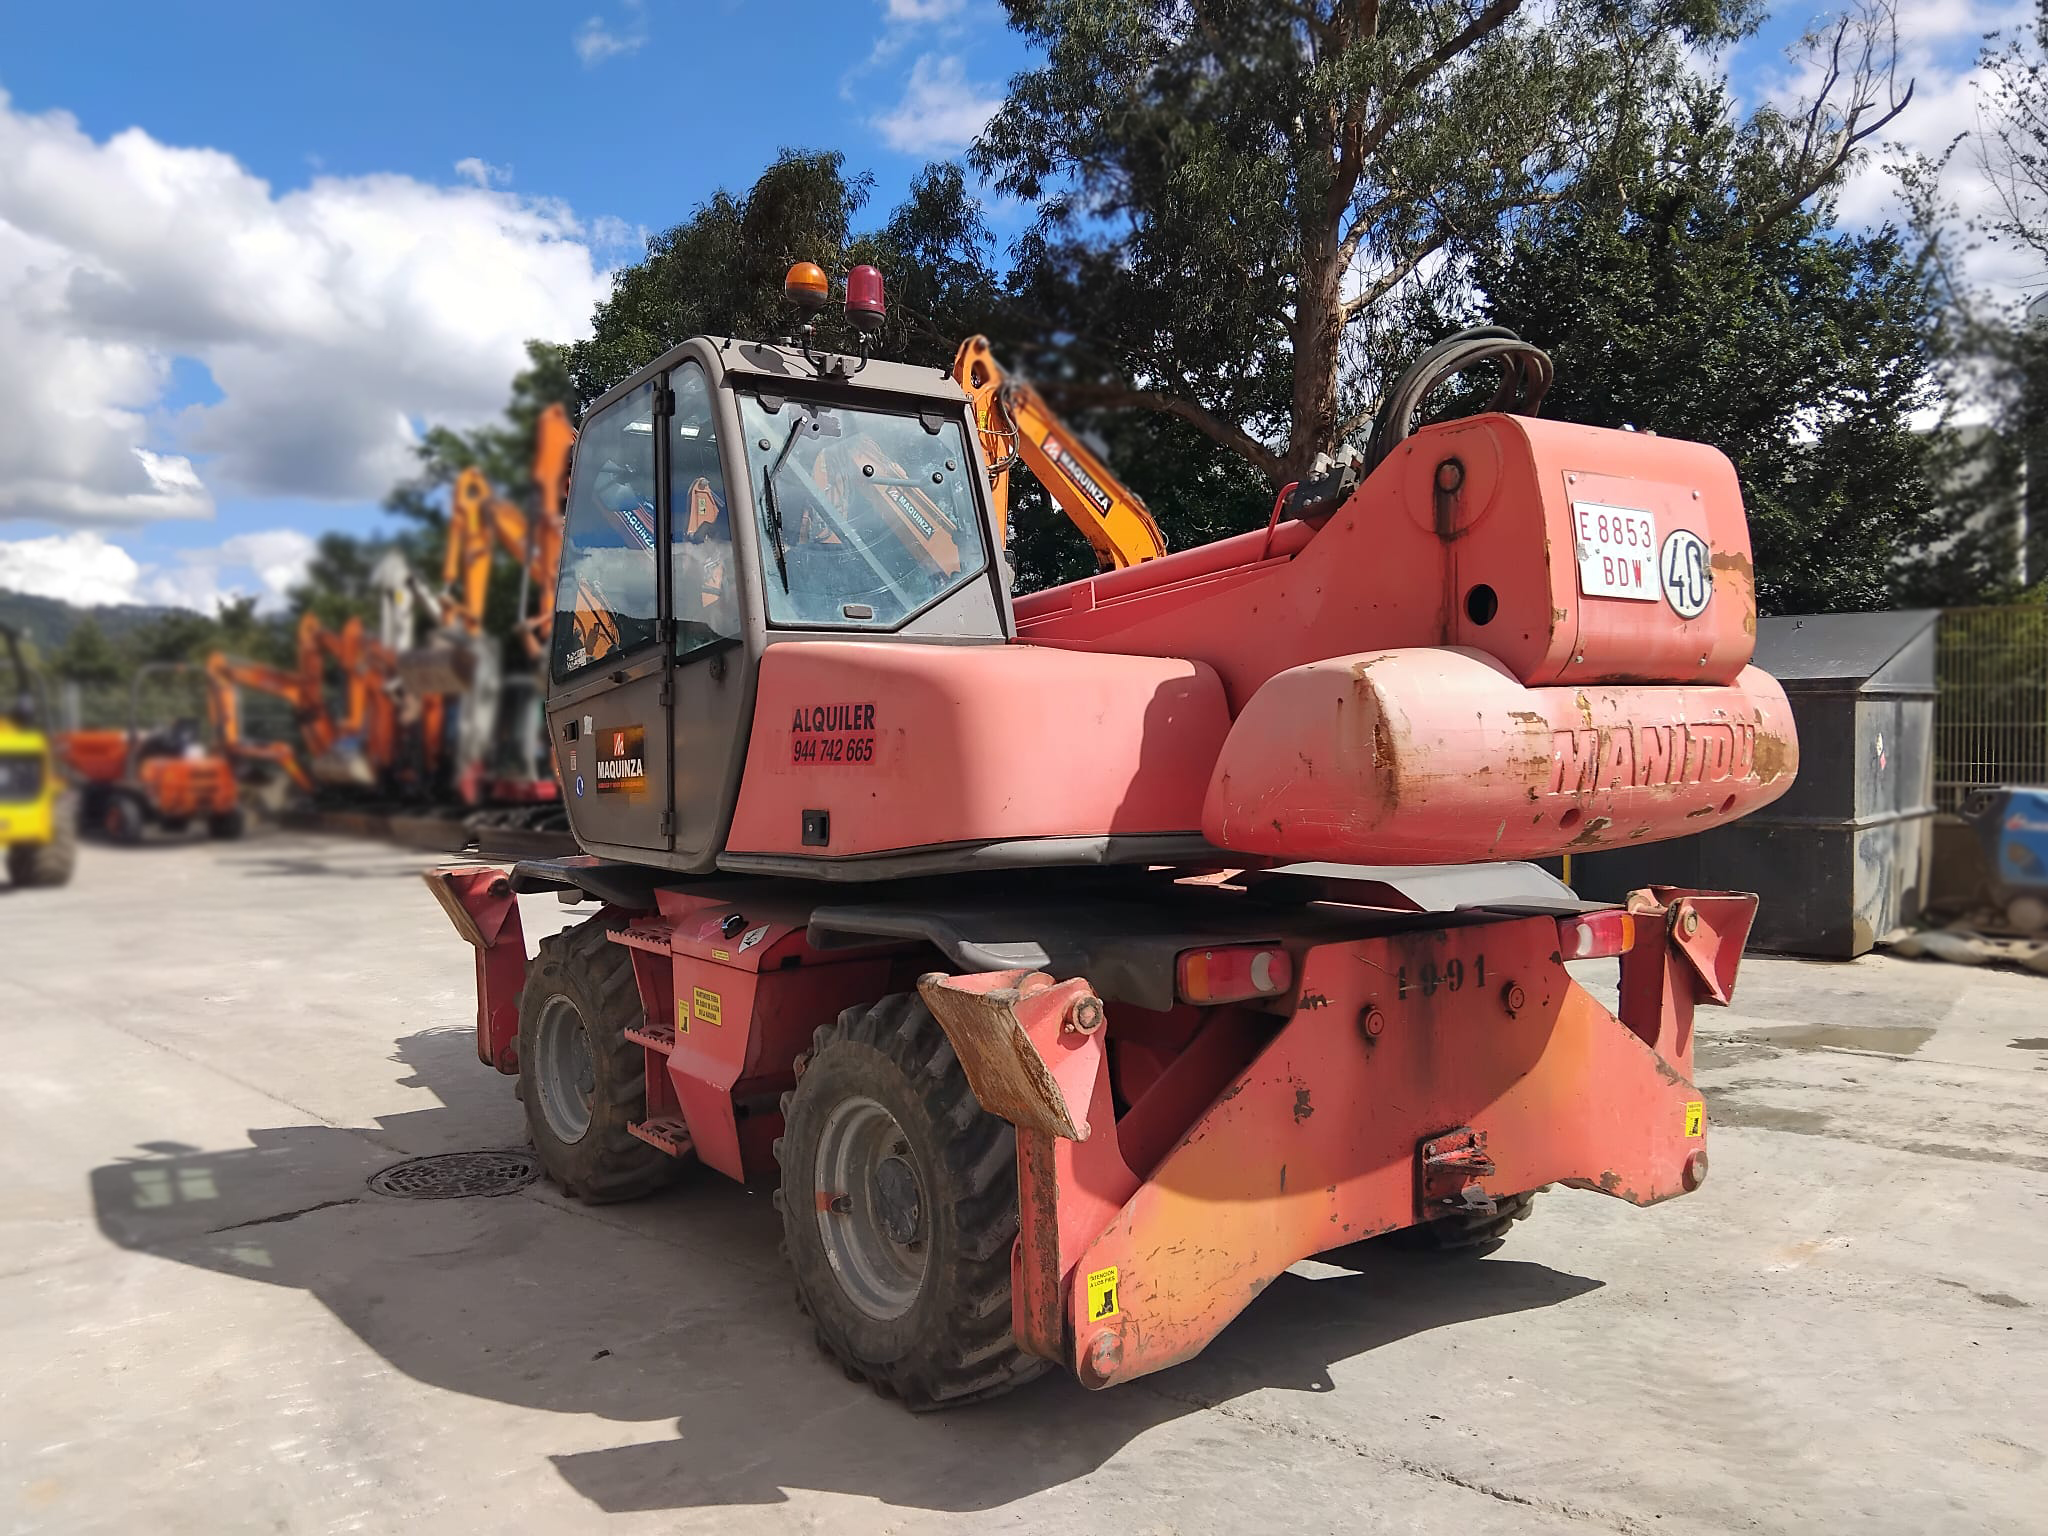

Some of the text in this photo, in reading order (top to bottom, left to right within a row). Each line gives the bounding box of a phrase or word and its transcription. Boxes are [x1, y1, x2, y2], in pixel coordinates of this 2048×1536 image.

[1060, 451, 1109, 511] MAQUINZA
[898, 495, 932, 536] MAQUINZA
[1602, 556, 1642, 588] BDW
[1668, 538, 1704, 608] 40
[791, 704, 876, 733] ALQUILER
[793, 737, 874, 762] 944 742 665
[597, 758, 643, 779] MAQUINZA
[1398, 953, 1486, 1001] 1991
